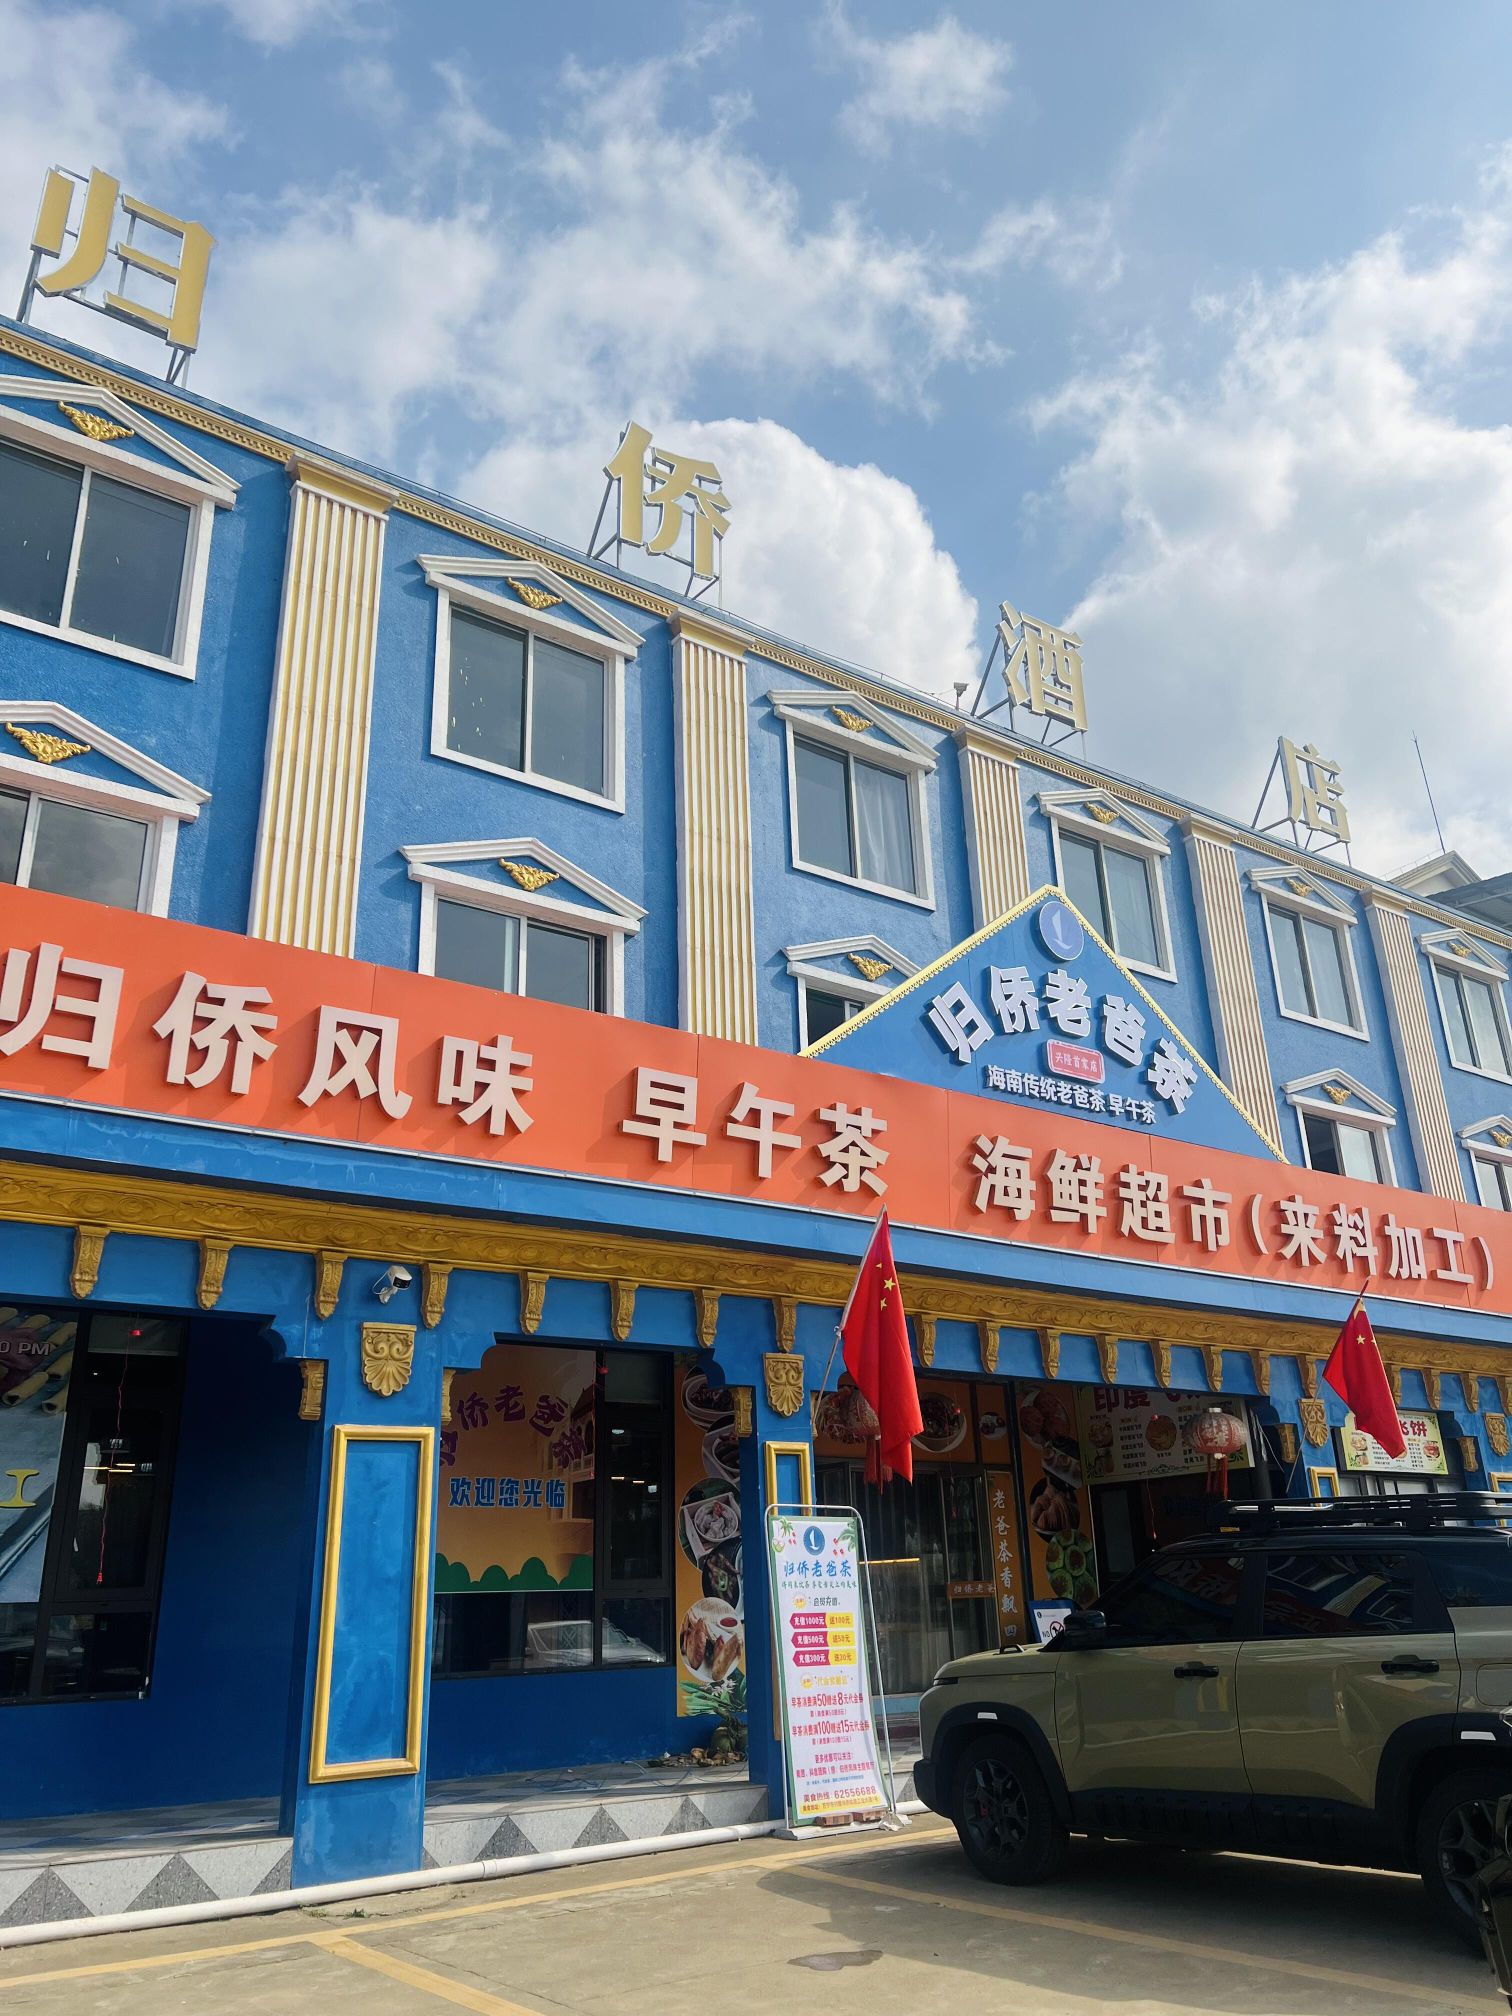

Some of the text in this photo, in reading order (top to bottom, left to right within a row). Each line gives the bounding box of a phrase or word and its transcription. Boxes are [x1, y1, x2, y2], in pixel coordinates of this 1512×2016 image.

[928, 965, 1198, 1114] 归侨老爸茶
[0, 942, 533, 1136] 归侨风味
[620, 1066, 890, 1197] 早午茶
[1055, 1052, 1098, 1073] 兴隆首家店
[987, 1065, 1158, 1124] 海南传统老爸茶 早午茶
[18, 1342, 50, 1356] PM
[448, 1476, 567, 1509] 欢迎您光临
[784, 1560, 852, 1578] 归侨老爸茶
